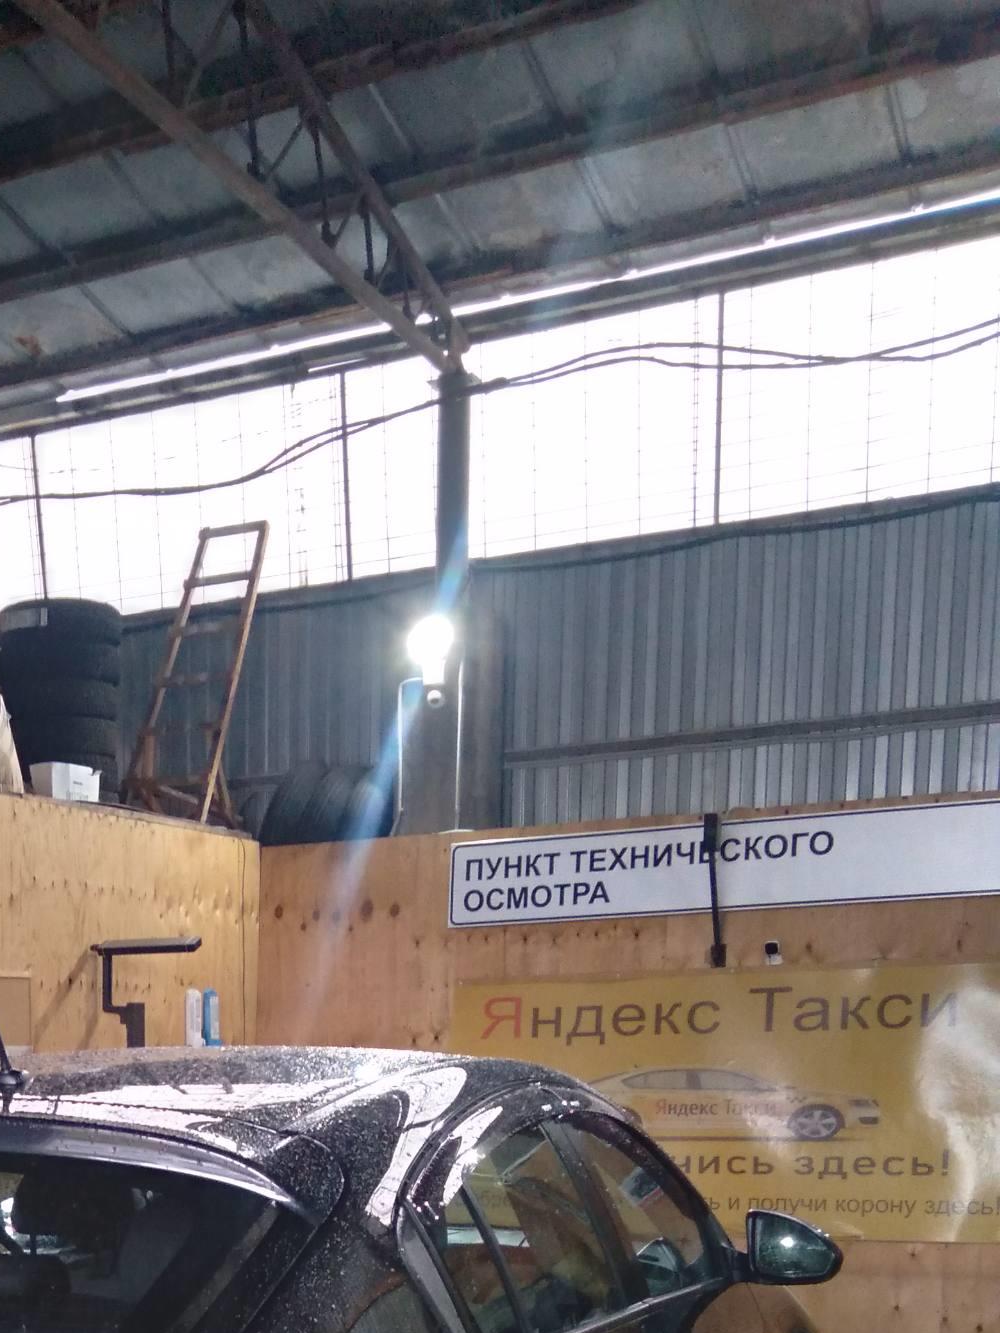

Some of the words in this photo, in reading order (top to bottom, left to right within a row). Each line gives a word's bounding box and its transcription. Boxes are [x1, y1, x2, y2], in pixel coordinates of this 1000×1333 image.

[465, 851, 560, 881] ПУНКТ
[463, 881, 610, 912] ОСМОТРА
[480, 996, 721, 1046] Яндекс
[749, 986, 958, 1034] Такси
[656, 1099, 719, 1117] Яндекс
[795, 1150, 950, 1180] здесь!
[728, 1198, 740, 1210] и
[748, 1198, 828, 1214] получи
[835, 1198, 917, 1218] корону
[924, 1196, 1000, 1218] здесь!
